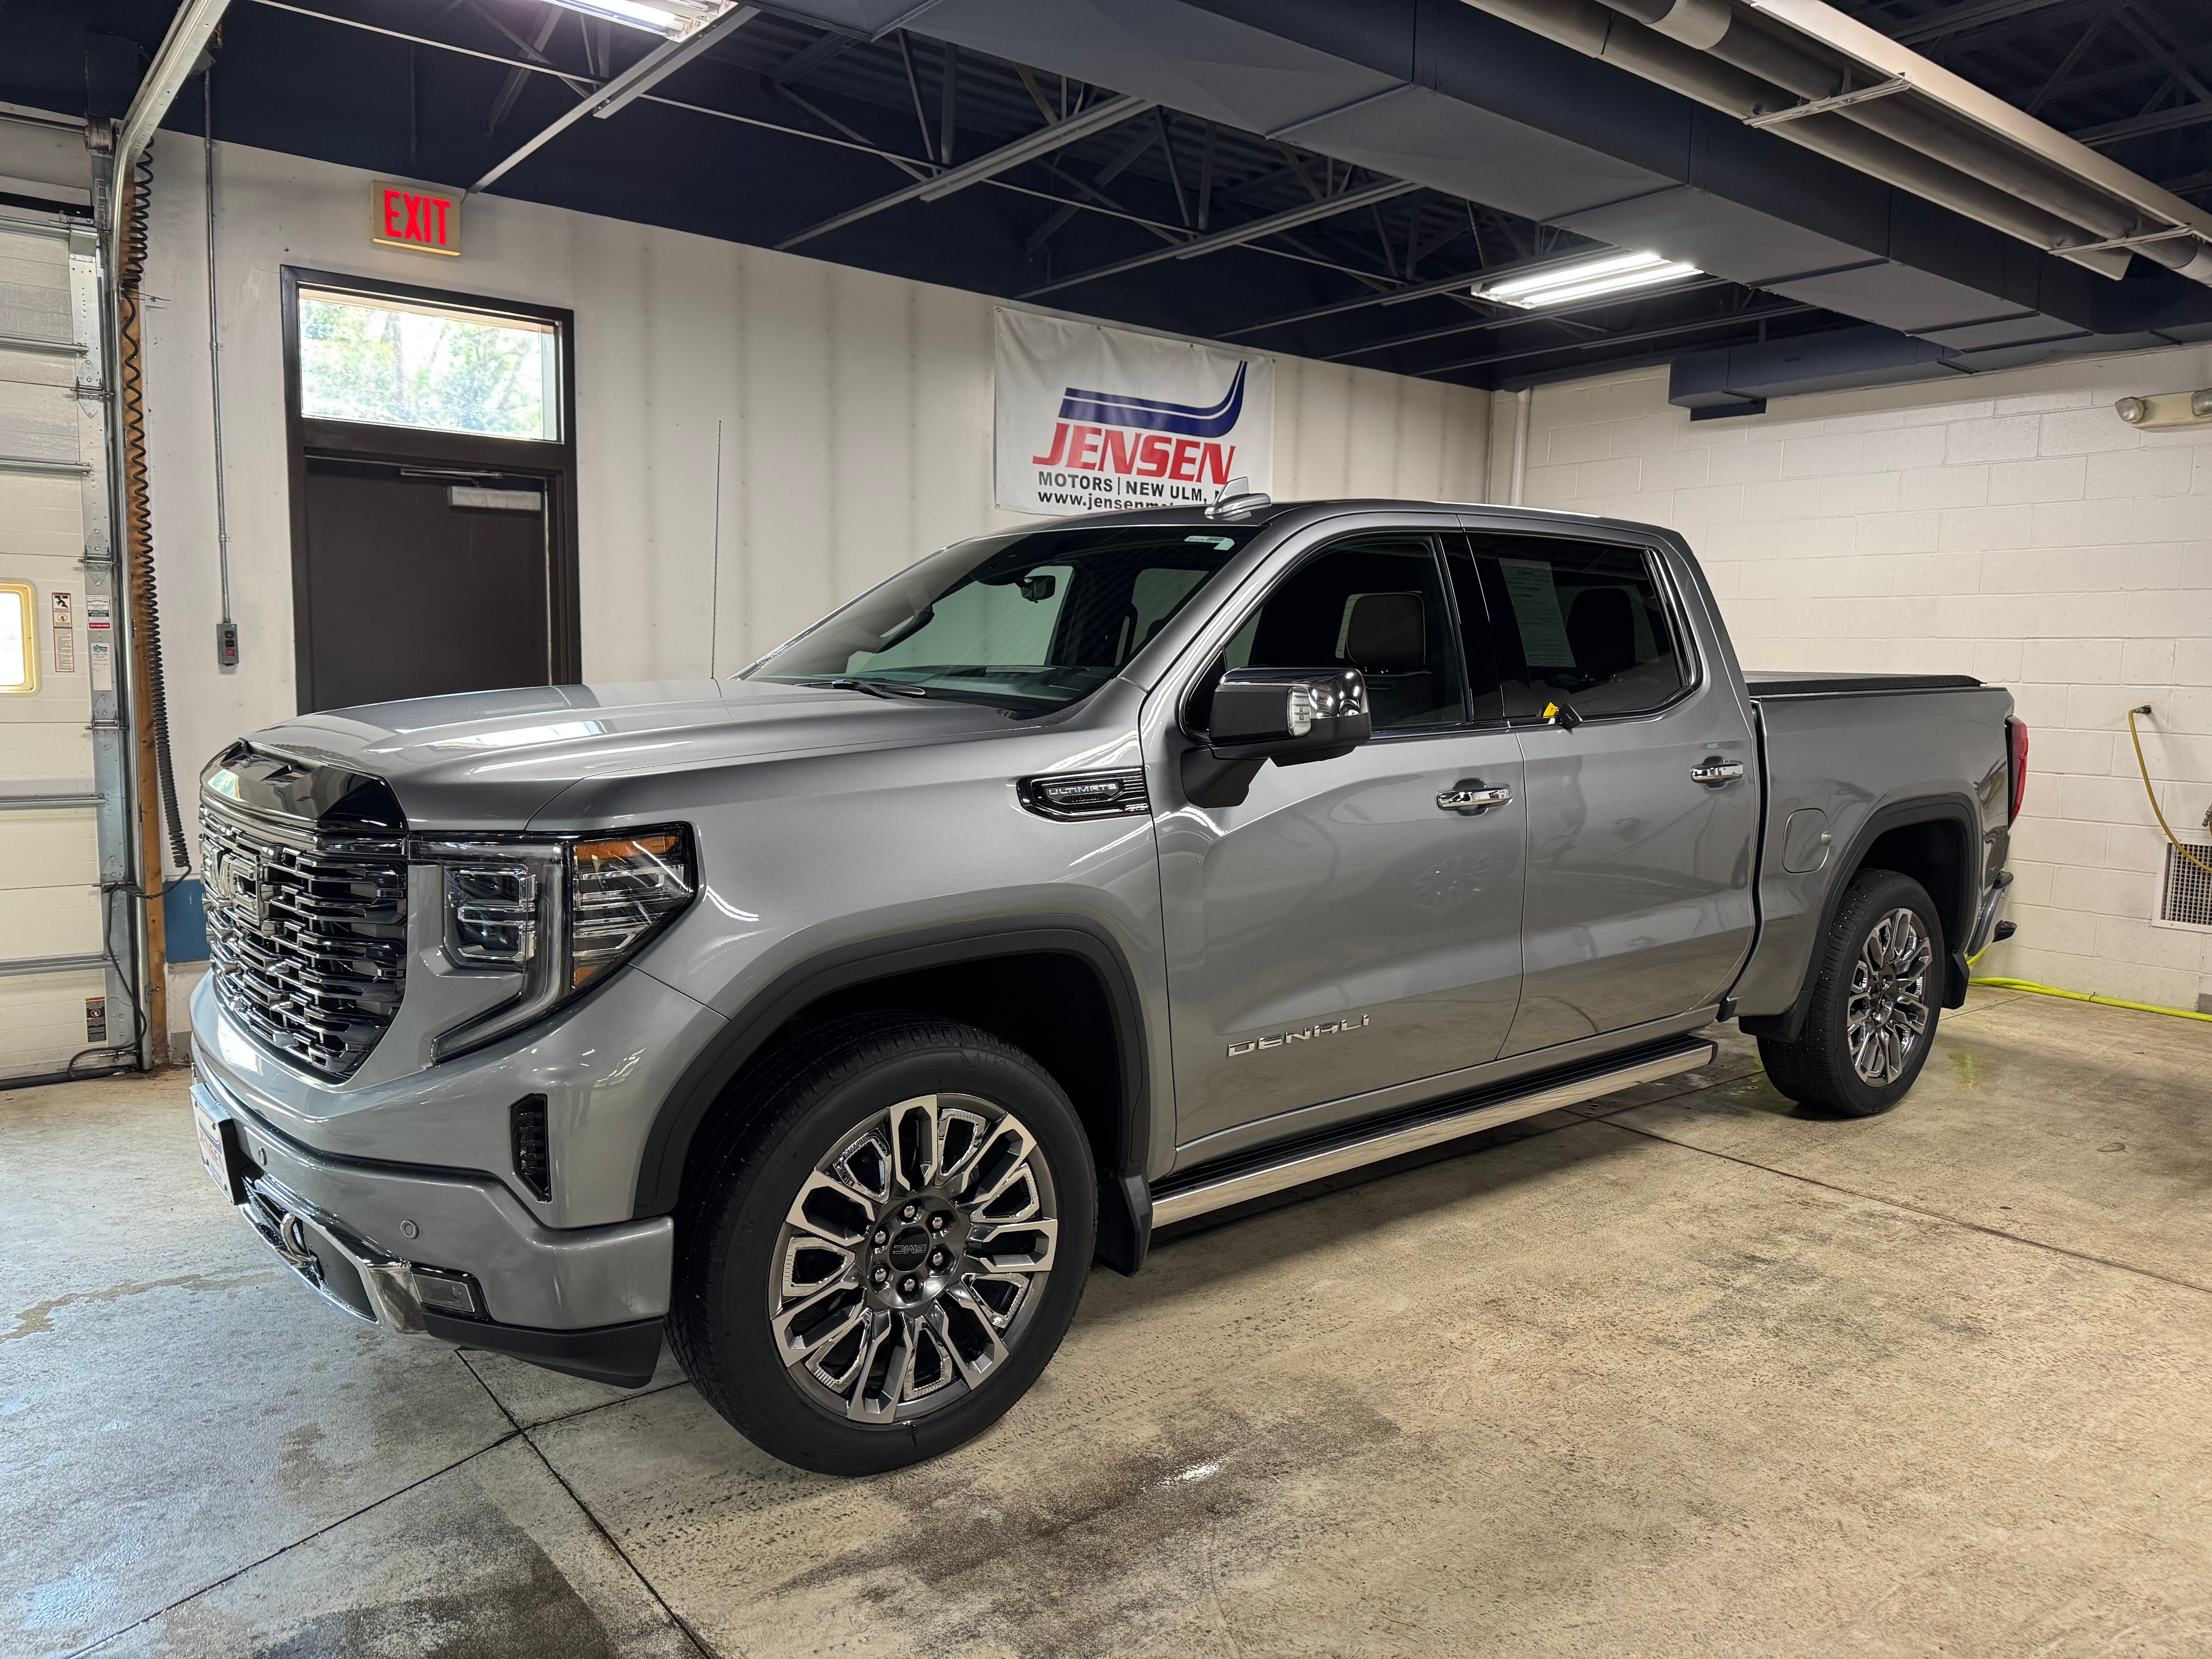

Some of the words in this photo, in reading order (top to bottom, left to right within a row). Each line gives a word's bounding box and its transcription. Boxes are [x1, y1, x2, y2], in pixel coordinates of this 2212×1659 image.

[384, 189, 450, 244] EXIT
[1032, 422, 1236, 484] JENSEN
[1038, 471, 1113, 492] MOTORS
[1126, 481, 1164, 497] NEW
[1170, 485, 1206, 504] ULM,
[1048, 783, 1117, 795] ULTIMATE
[1227, 1013, 1369, 1057] DENALI
[893, 1244, 927, 1254] GMC
